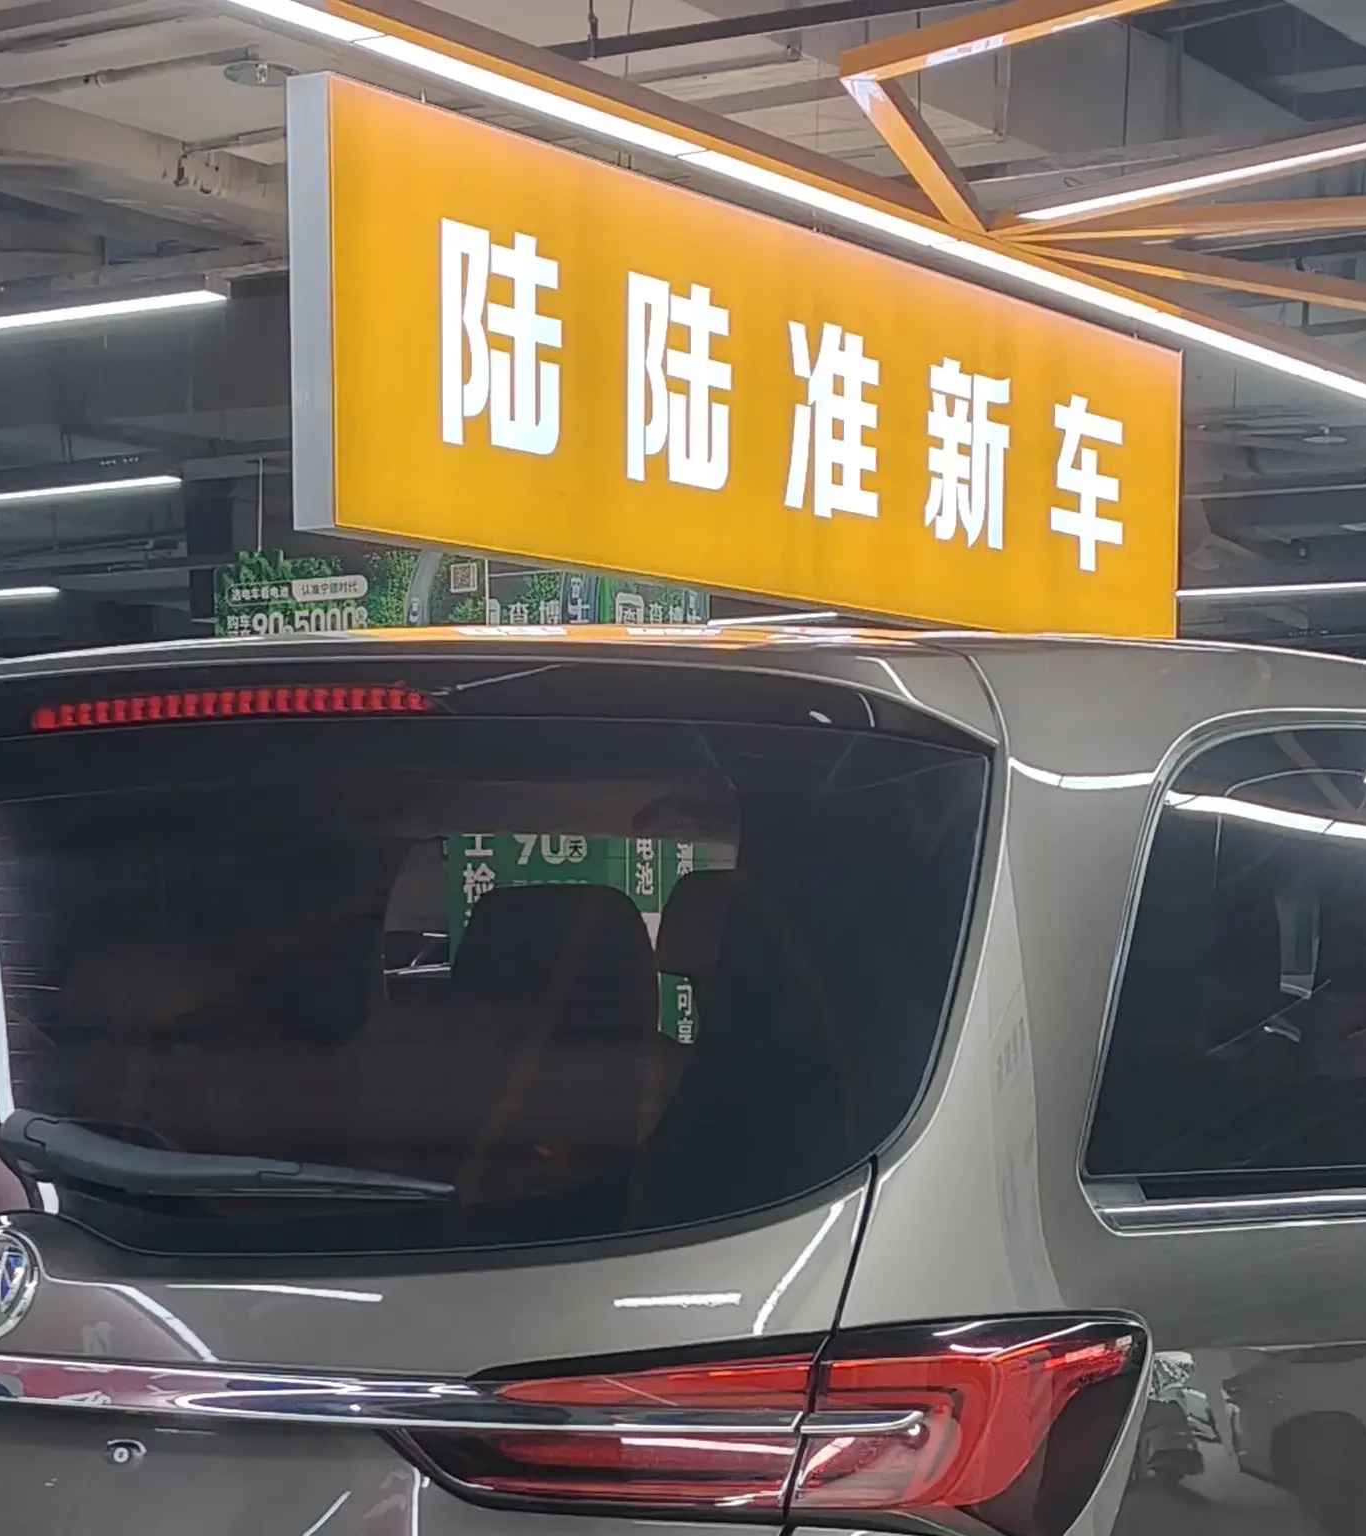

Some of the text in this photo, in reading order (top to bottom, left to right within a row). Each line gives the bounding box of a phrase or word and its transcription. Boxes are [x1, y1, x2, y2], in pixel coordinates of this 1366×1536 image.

[439, 215, 1124, 573] 陆陆准新车
